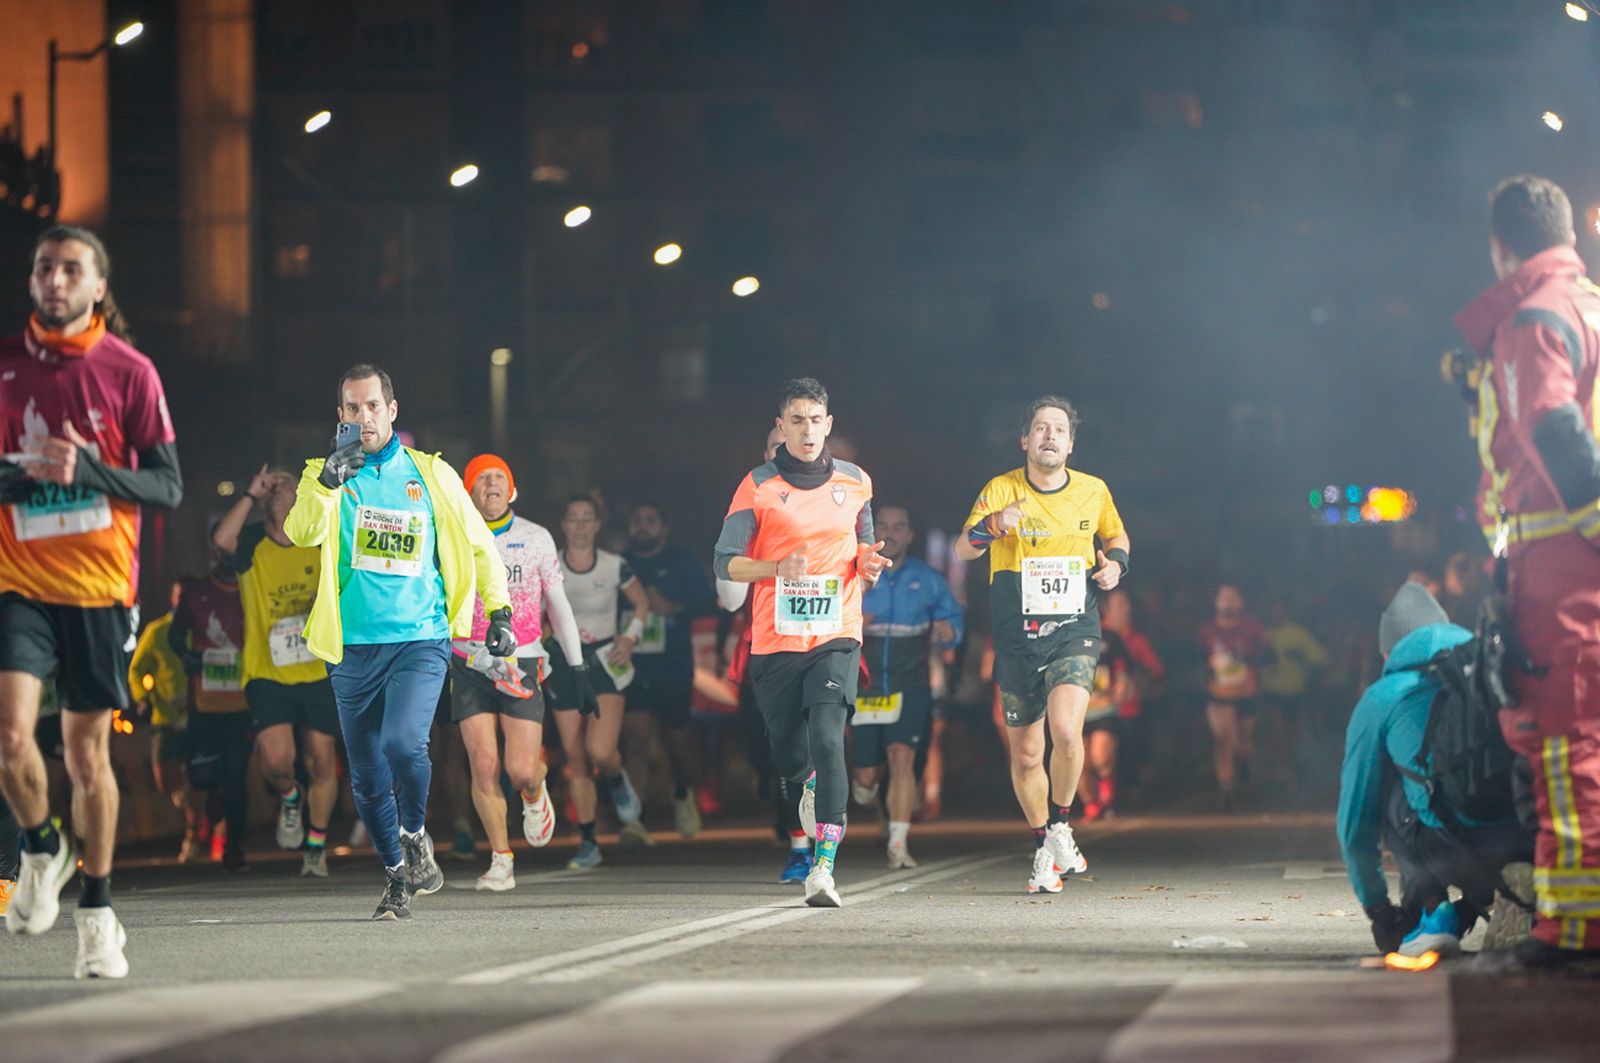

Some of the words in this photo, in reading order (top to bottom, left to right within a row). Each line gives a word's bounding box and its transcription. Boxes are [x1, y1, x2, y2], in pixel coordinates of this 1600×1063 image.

[363, 521, 377, 529] SAN
[366, 530, 415, 554] 2039
[1041, 578, 1069, 594] 547
[788, 597, 831, 615] 12177
